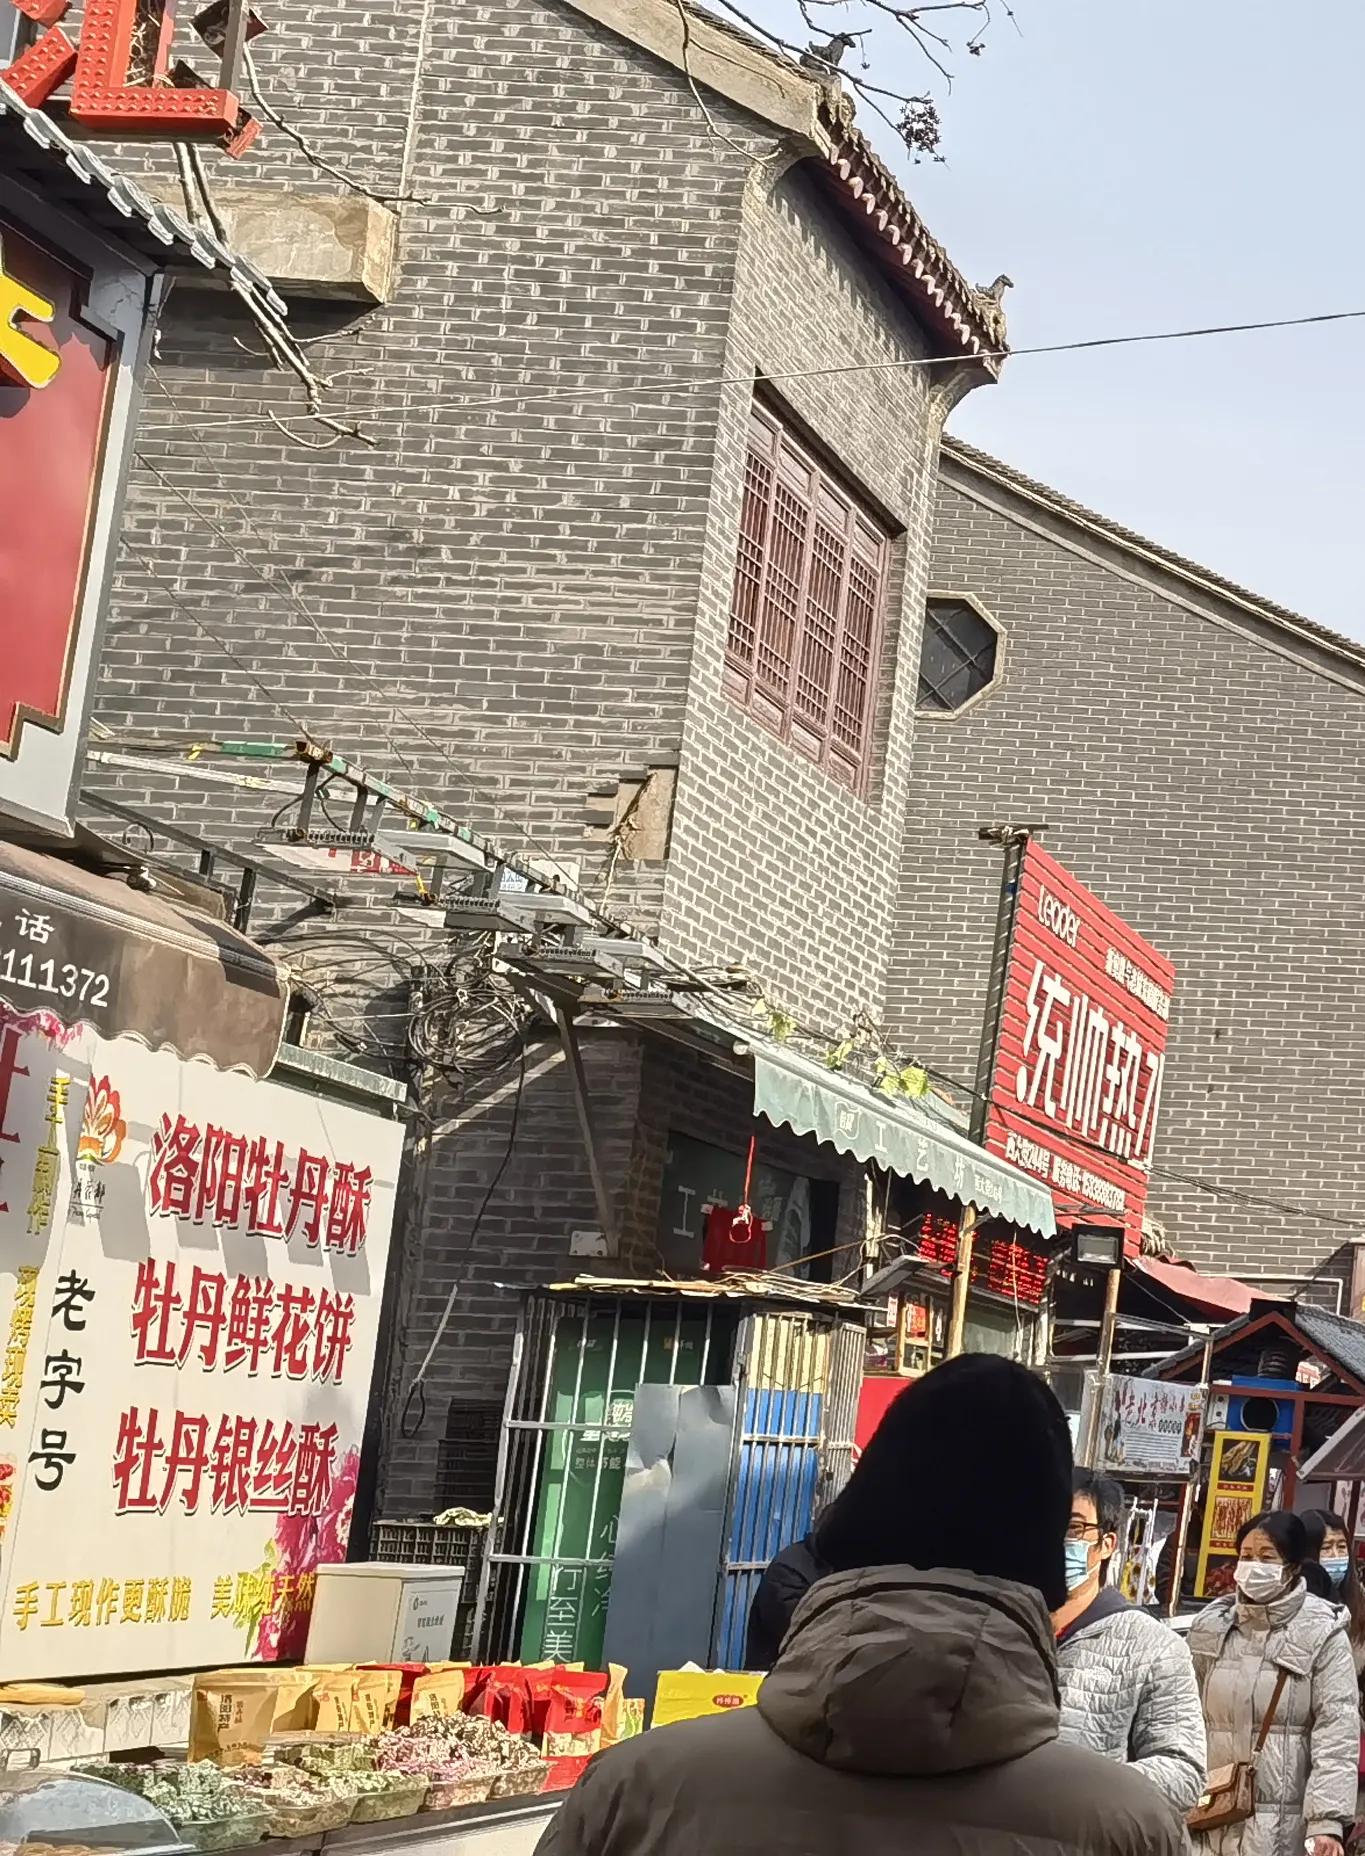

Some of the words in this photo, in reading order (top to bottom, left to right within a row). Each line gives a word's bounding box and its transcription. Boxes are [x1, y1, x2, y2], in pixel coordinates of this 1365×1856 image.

[14, 908, 55, 944] 话
[1038, 885, 1081, 949] Leader
[148, 1111, 374, 1253] 洛阳牡丹酥
[28, 1269, 96, 1491] 老字号
[130, 1257, 357, 1385] 牡丹鲜花饼
[112, 1406, 339, 1518] 牡丹银丝酥
